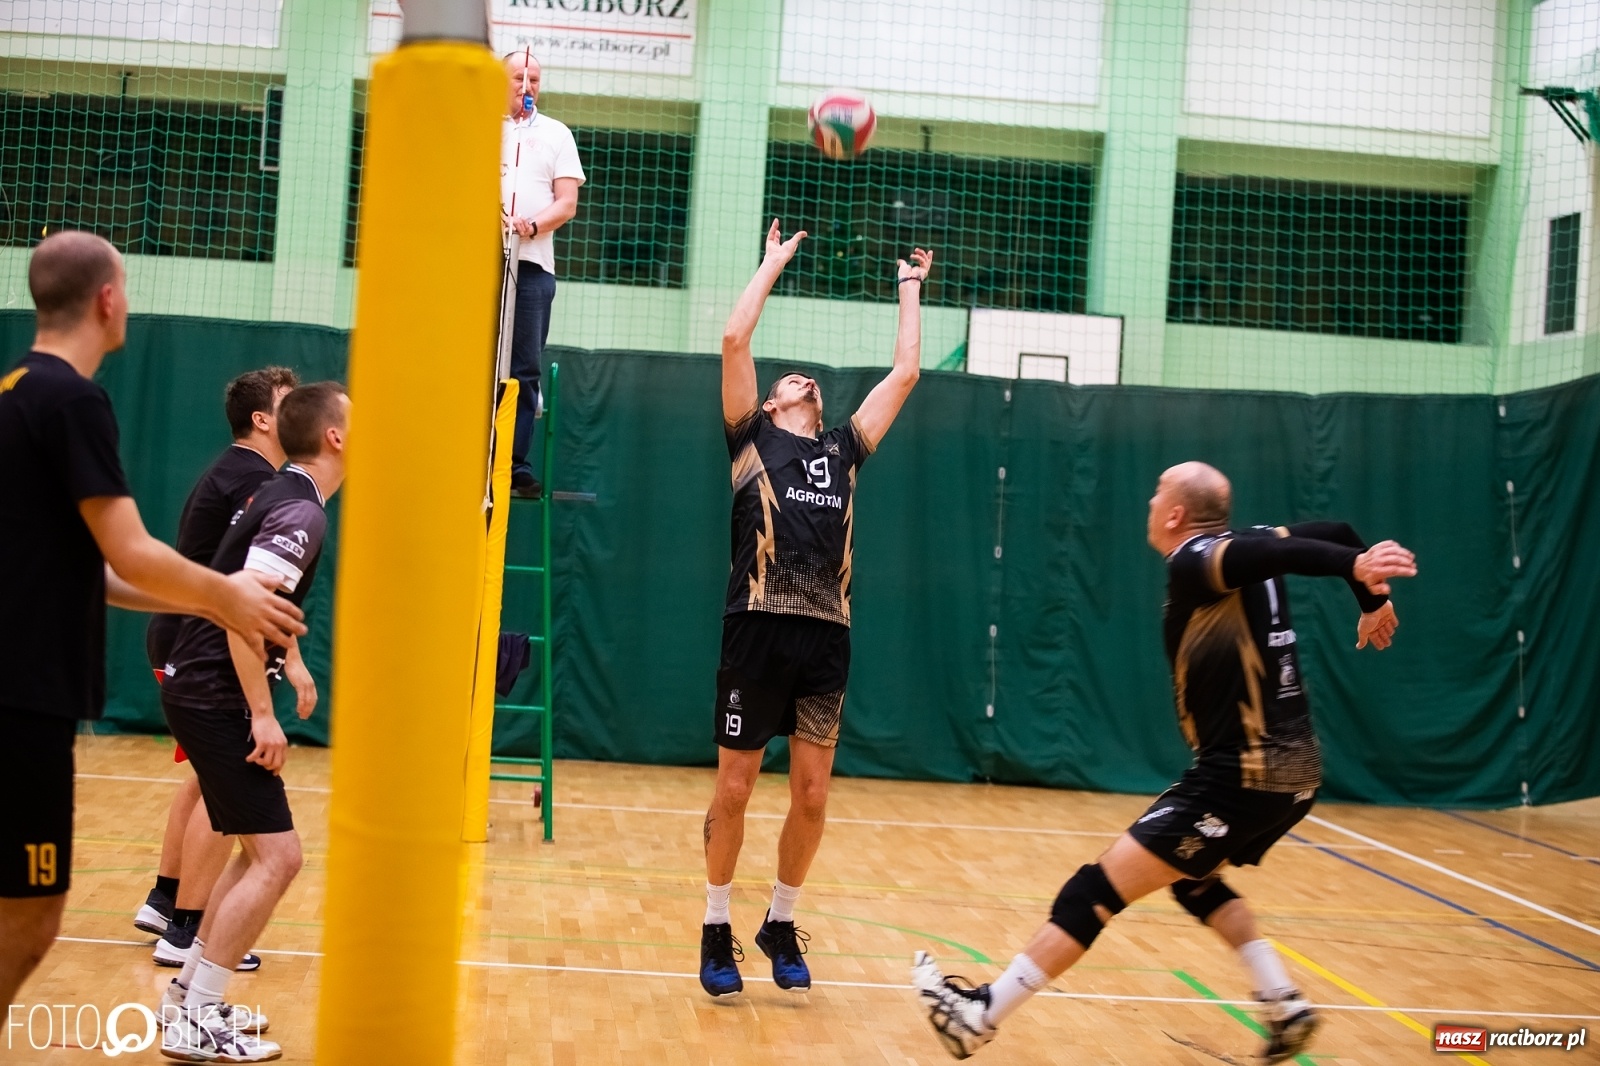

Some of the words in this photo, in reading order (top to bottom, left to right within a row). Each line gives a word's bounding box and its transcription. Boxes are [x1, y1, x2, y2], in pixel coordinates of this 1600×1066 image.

[516, 35, 671, 60] www.raciborz.pl
[802, 456, 831, 488] 19
[275, 536, 303, 557] ORLEN
[725, 712, 742, 736] 19
[25, 843, 57, 886] 19
